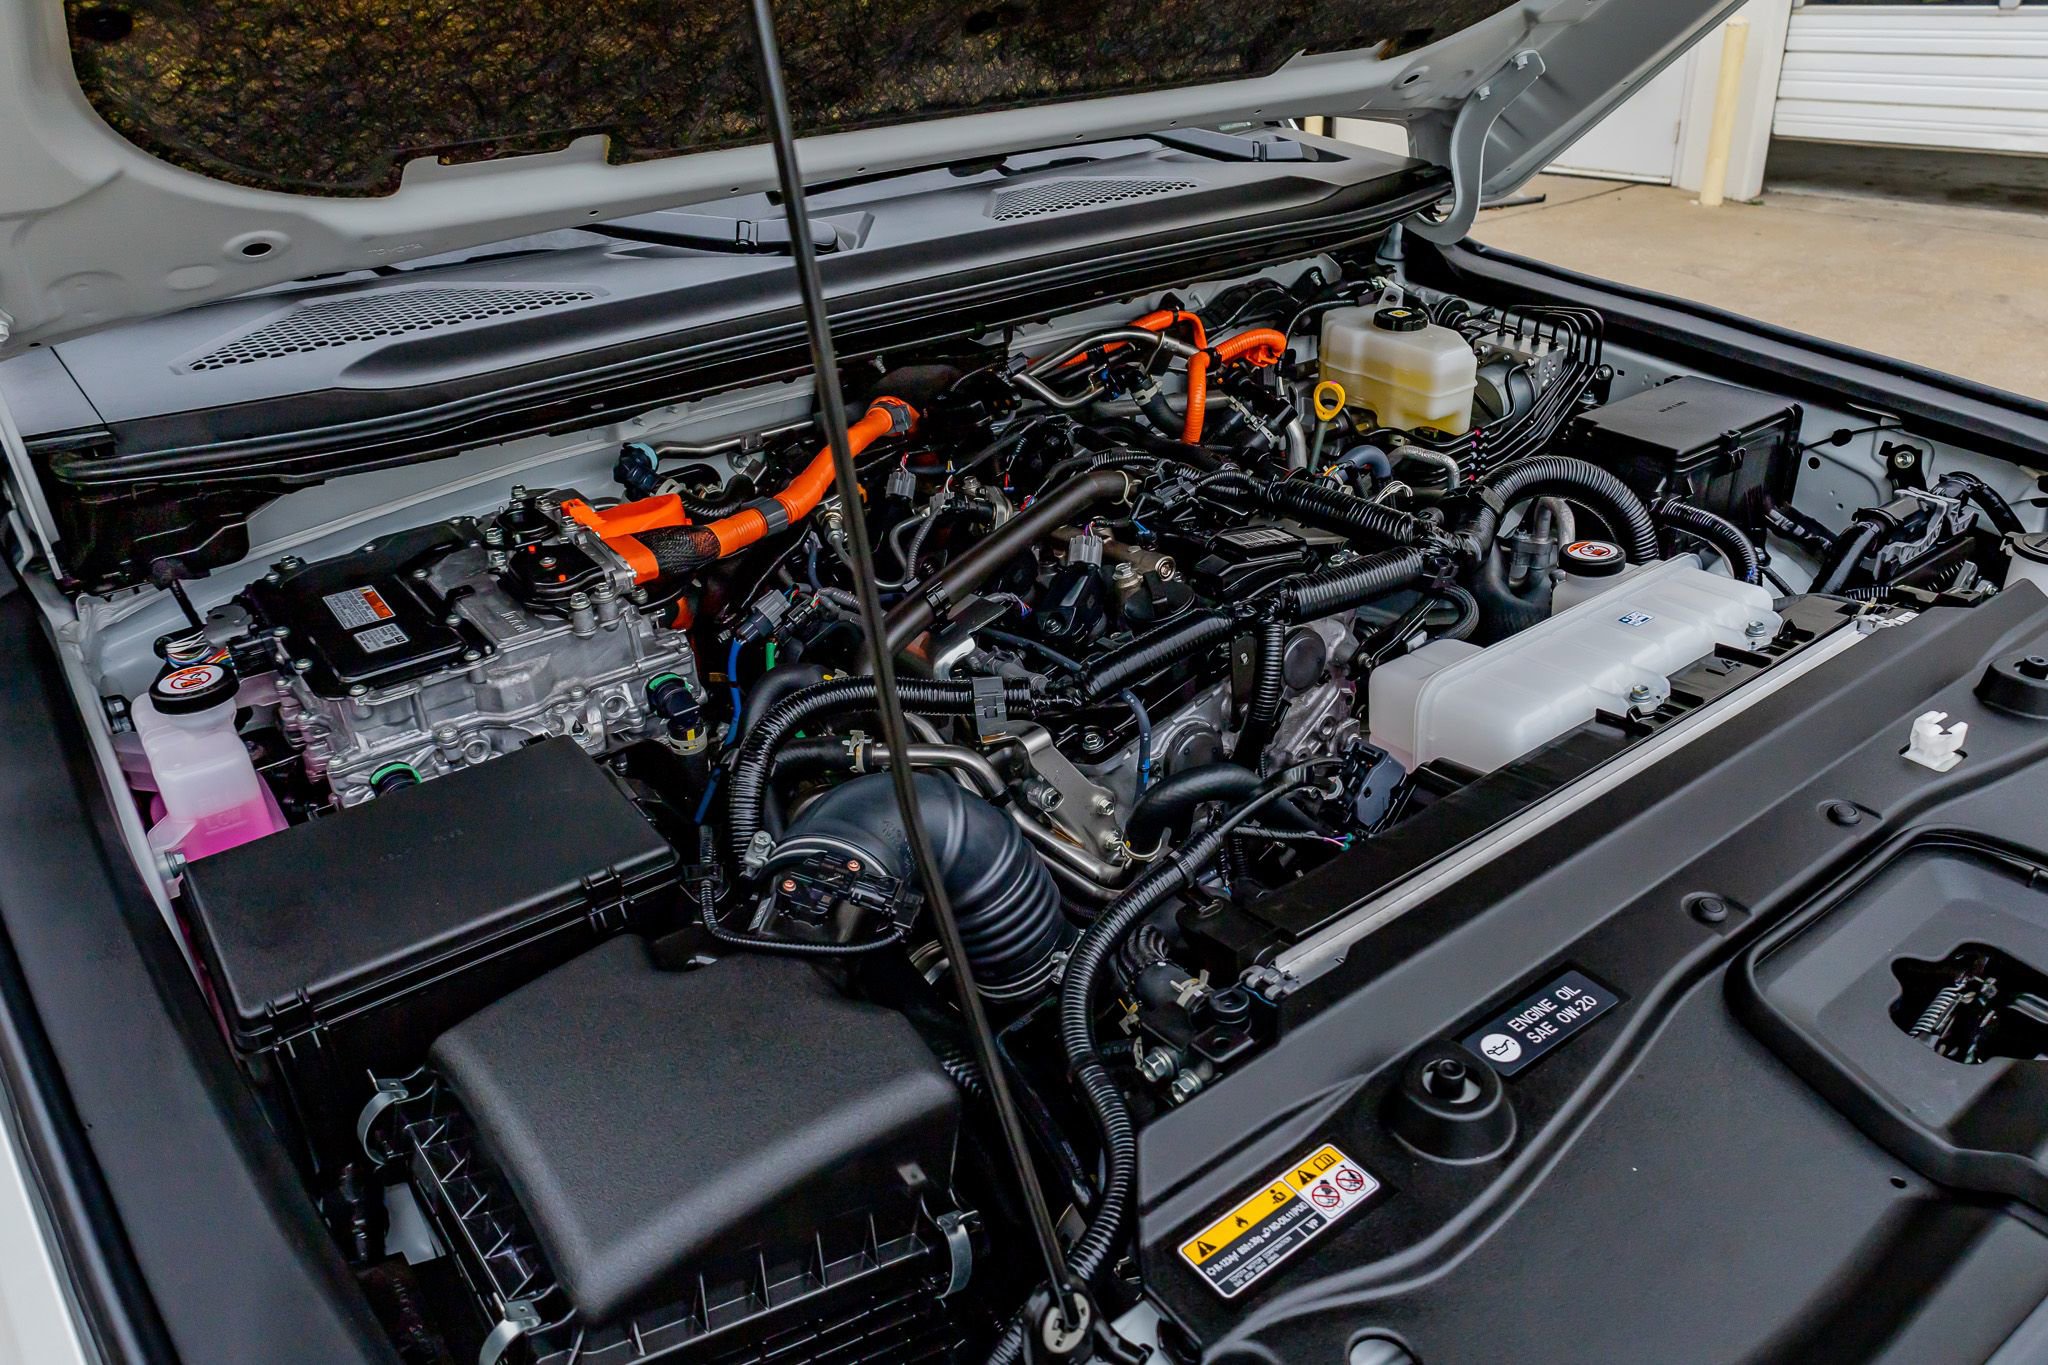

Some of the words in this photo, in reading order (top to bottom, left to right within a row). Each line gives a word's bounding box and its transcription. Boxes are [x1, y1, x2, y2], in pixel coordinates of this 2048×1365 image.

[1507, 998, 1558, 1032] ENGINE
[1555, 985, 1582, 1000] OIL
[1526, 1021, 1559, 1043] SAE
[1556, 995, 1597, 1023] 0W-20
[1306, 1219, 1320, 1230] VP
